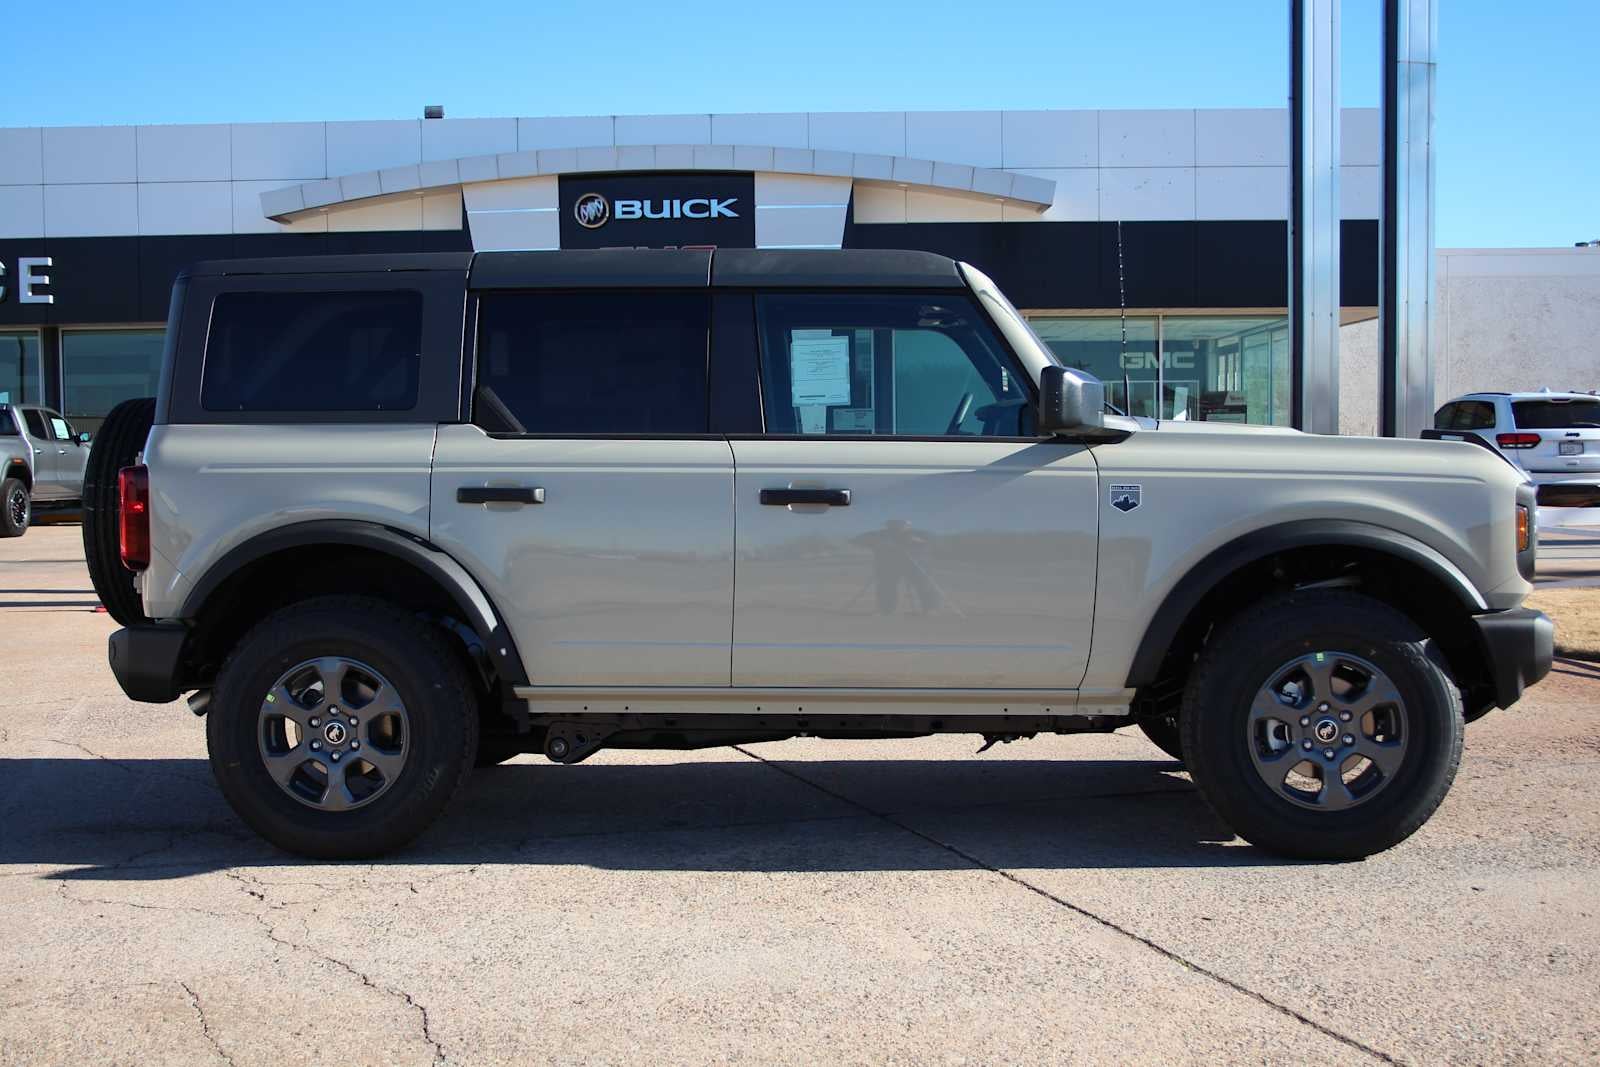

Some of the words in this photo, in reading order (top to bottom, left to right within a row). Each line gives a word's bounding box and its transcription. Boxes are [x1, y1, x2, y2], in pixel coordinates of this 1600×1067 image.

[614, 199, 740, 219] BUICK
[0, 256, 54, 304] E
[1119, 351, 1195, 369] GMC
